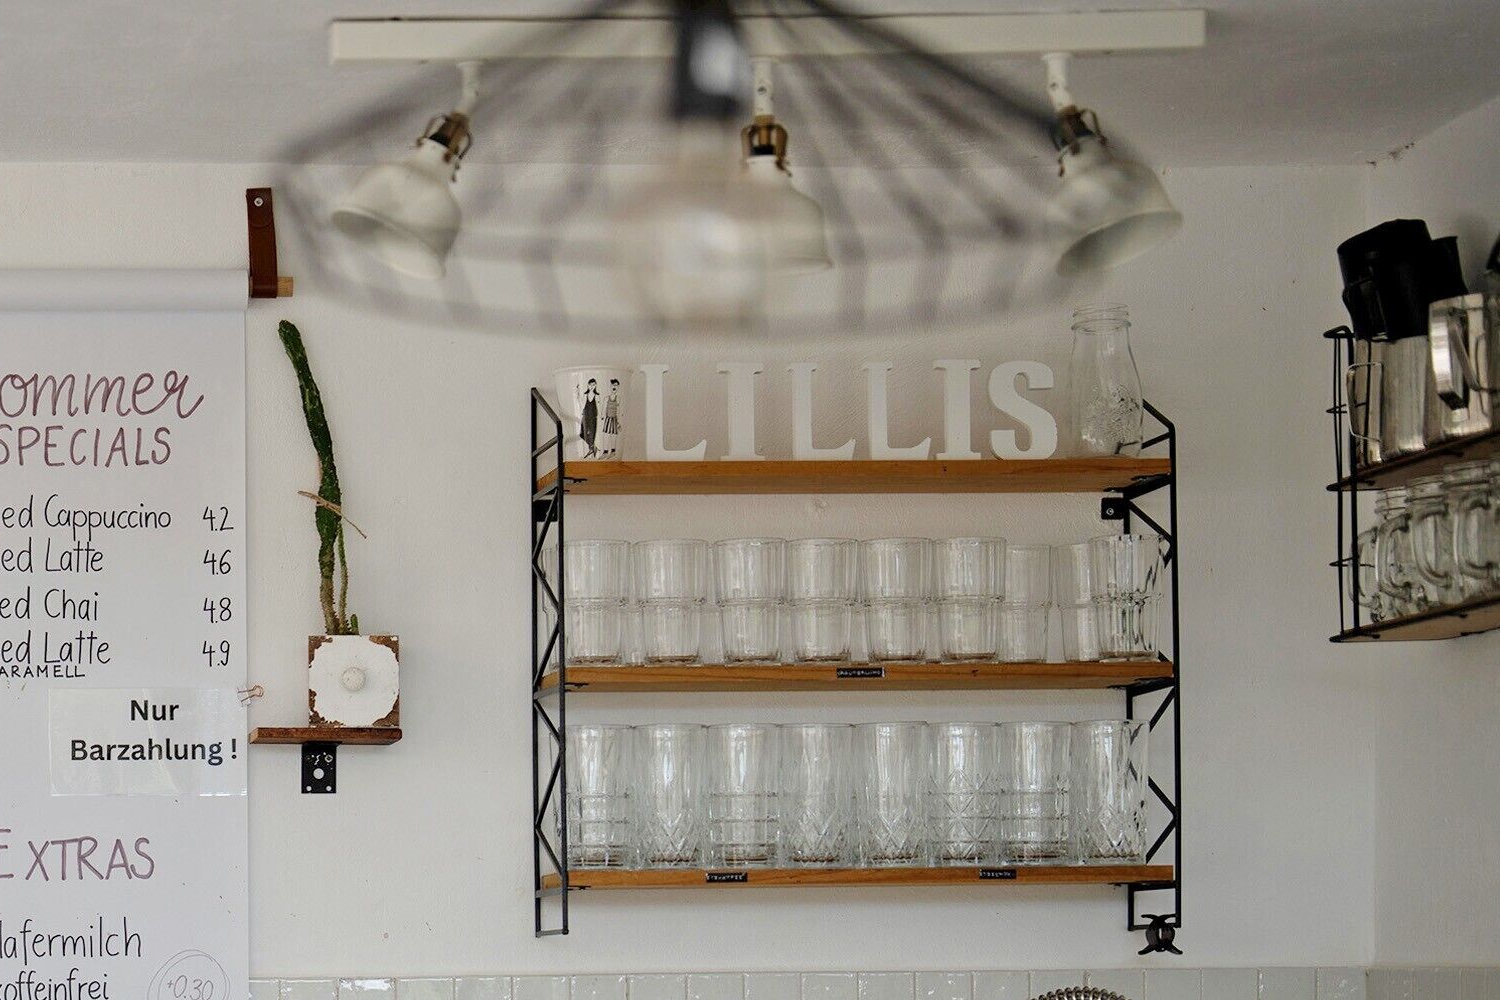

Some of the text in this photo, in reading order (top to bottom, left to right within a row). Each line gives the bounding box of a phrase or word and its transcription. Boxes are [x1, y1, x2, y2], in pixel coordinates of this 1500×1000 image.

[640, 359, 1058, 461] LILLIS
[44, 493, 172, 542] Cappuccino
[45, 537, 104, 574] Latte
[43, 588, 100, 622] Chai
[43, 630, 112, 665] Latte
[130, 699, 179, 721] Nur
[70, 738, 223, 766] Barzahlung
